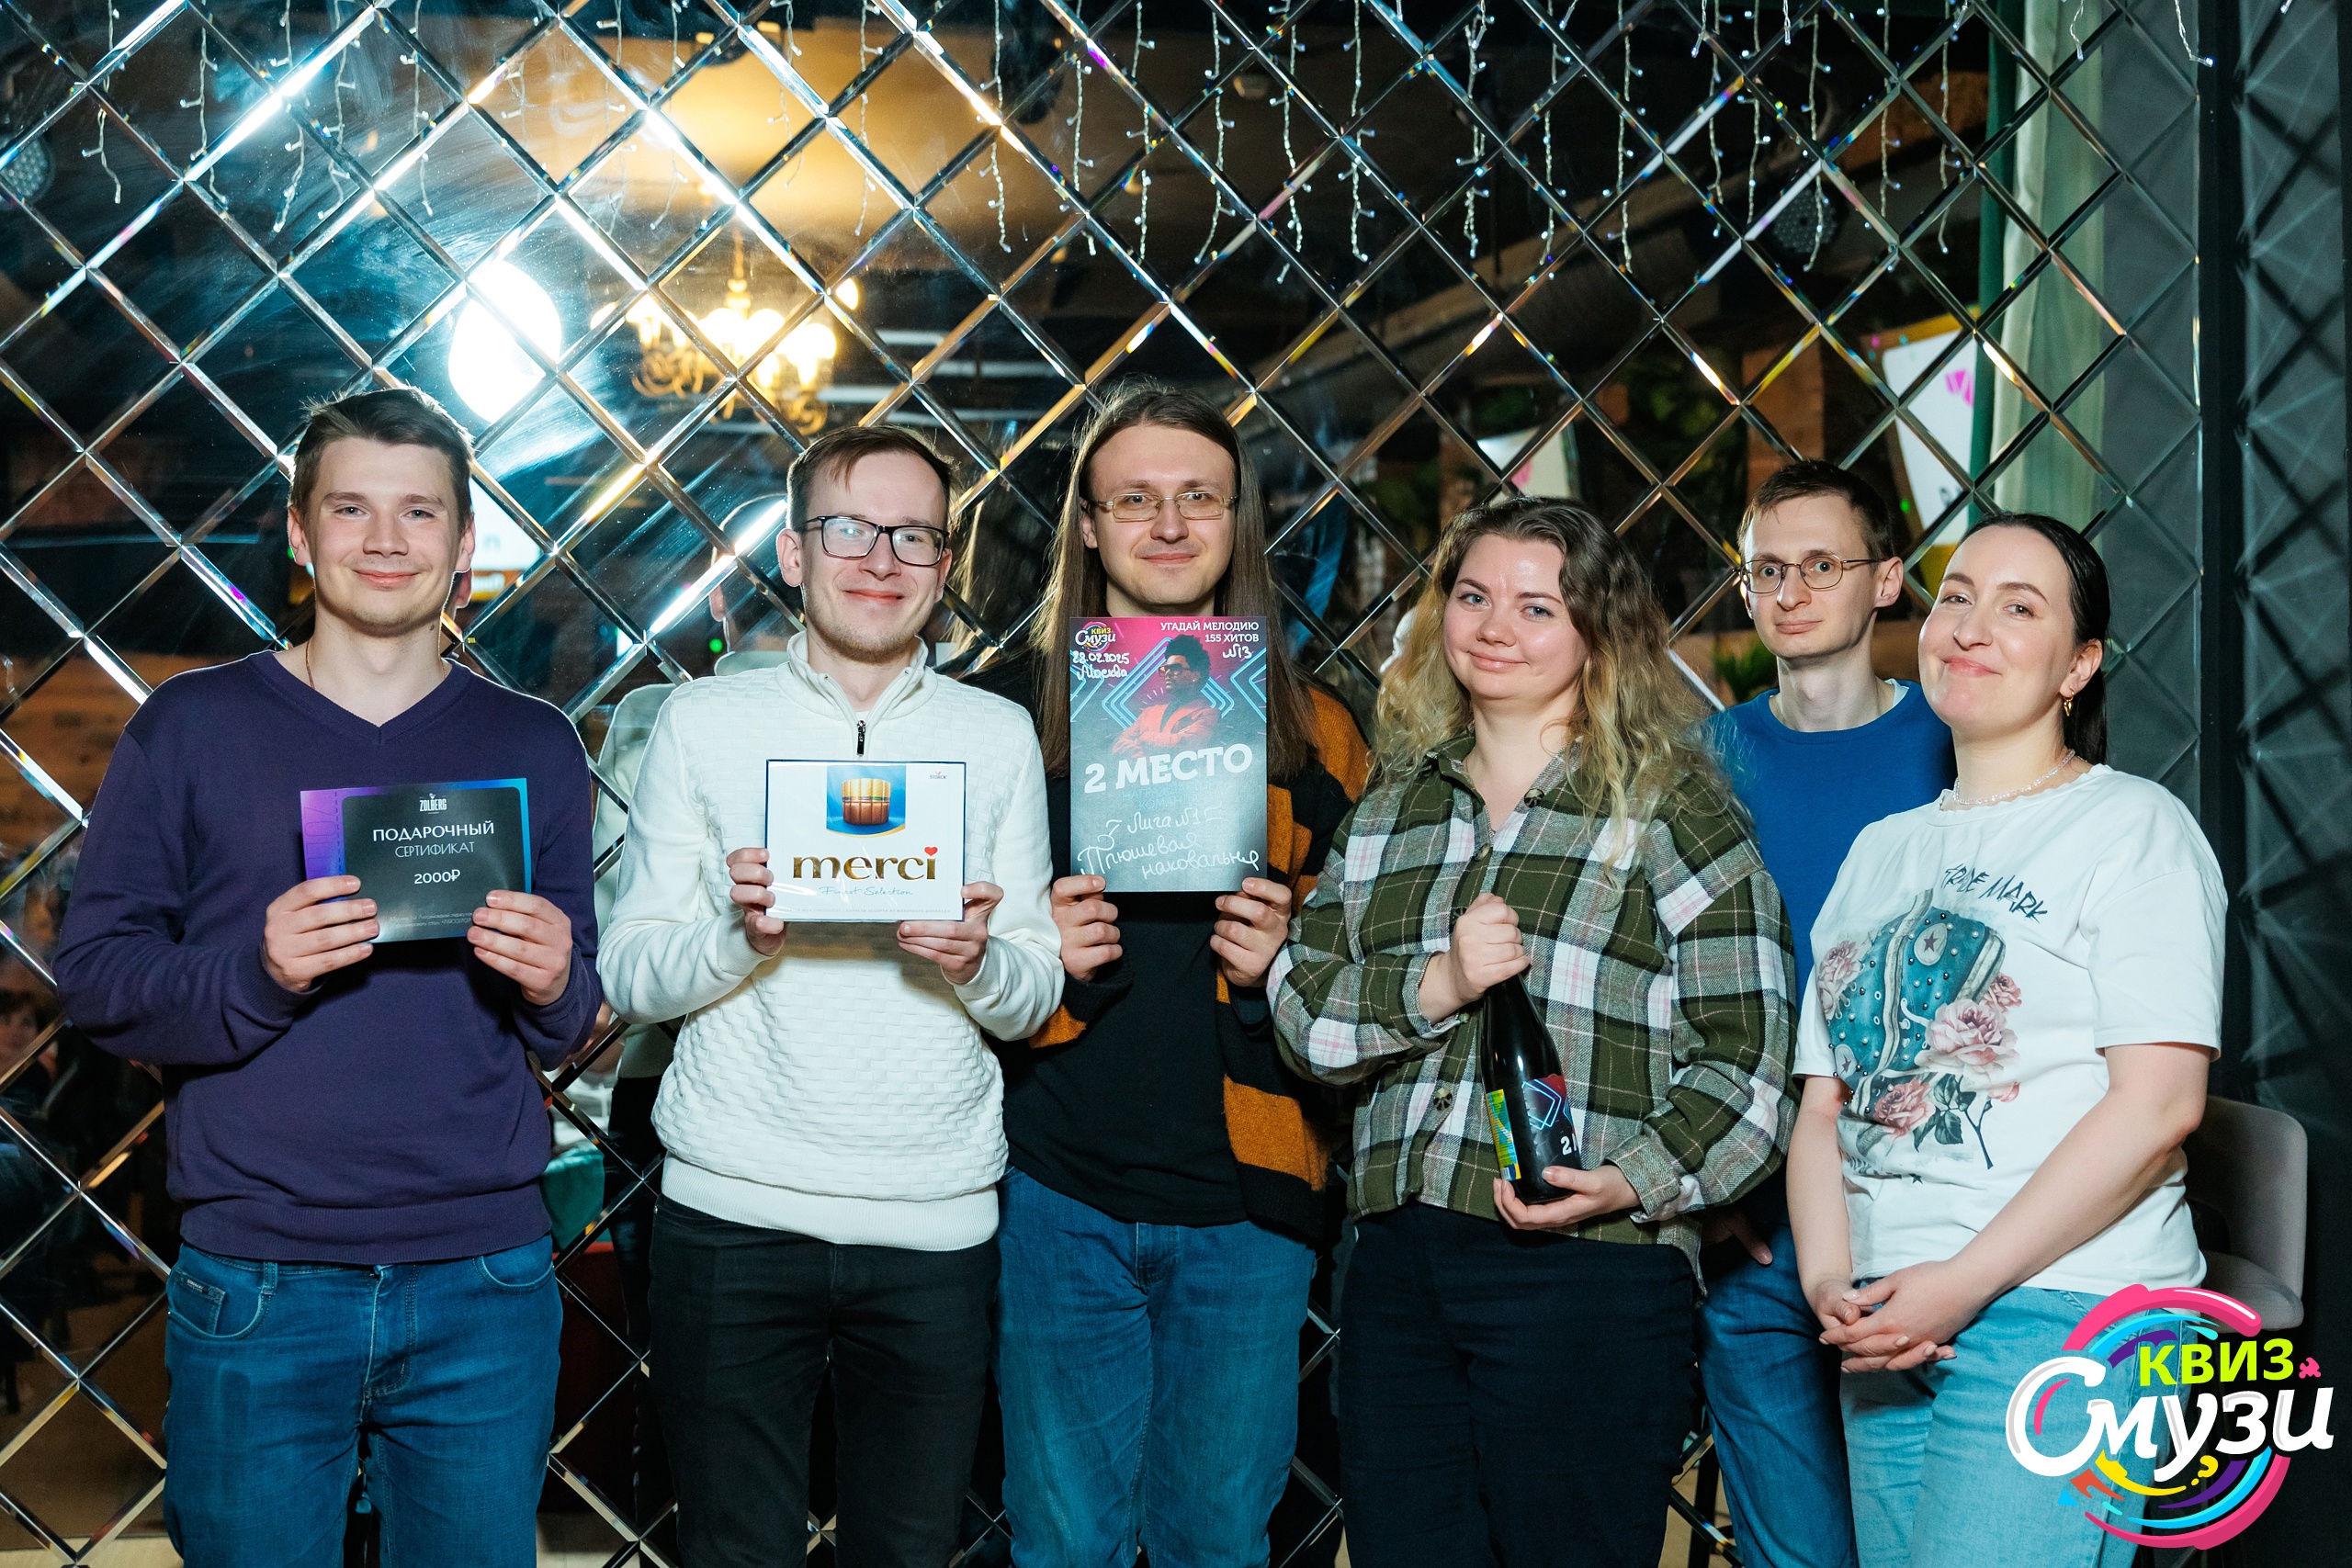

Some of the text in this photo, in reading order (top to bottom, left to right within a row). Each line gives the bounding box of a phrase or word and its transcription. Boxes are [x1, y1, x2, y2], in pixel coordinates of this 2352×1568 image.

[1160, 620, 1259, 632] УГАДАЙ МЕЛОДИЮ
[1075, 630, 1116, 646] Смузи
[1204, 634, 1259, 642] 155 ХИТОВ
[1072, 650, 1130, 664] 28.02.2025
[1077, 664, 1128, 680] Москва
[1084, 743, 1253, 794] 2 МЕСТО
[419, 798, 447, 812] ZOLBERG
[373, 820, 495, 841] ПОДАРОЧНЫЙ
[1127, 812, 1171, 834] Лига
[395, 841, 475, 858] СЕРТИФИКАТ
[792, 847, 938, 881] merci
[413, 869, 461, 885] 2000₽
[864, 886, 914, 896] Selection
[1978, 874, 2048, 924] MARK
[1560, 1135, 1572, 1156] 2
